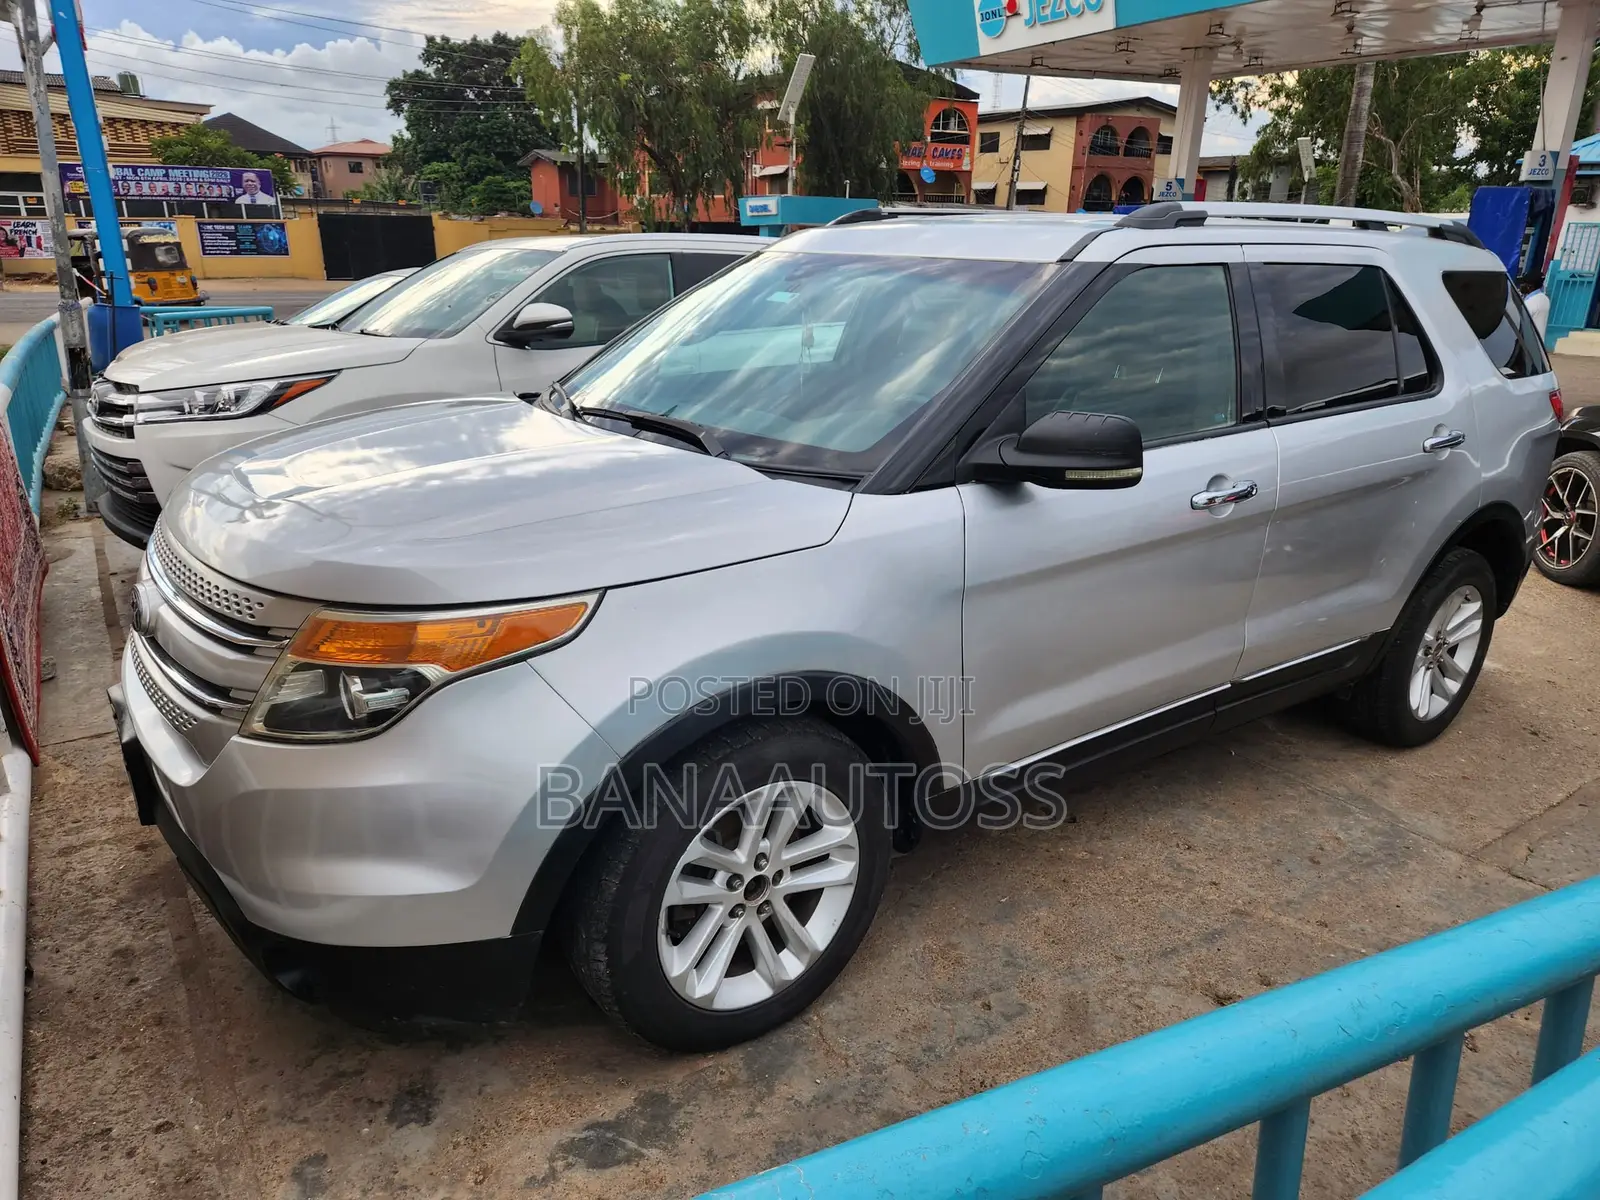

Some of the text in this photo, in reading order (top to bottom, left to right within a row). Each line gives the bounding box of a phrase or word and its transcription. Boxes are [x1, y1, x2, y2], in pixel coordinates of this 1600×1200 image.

[932, 146, 963, 160] CAKES
[929, 160, 954, 168] training
[1538, 155, 1547, 167] 3
[113, 167, 133, 176] BAL
[137, 168, 166, 177] CAMP
[168, 168, 209, 178] MEETING
[1528, 168, 1549, 176] JEZCO
[1165, 181, 1173, 191] 5
[13, 221, 37, 229] LEARN
[10, 228, 38, 236] FRENCH
